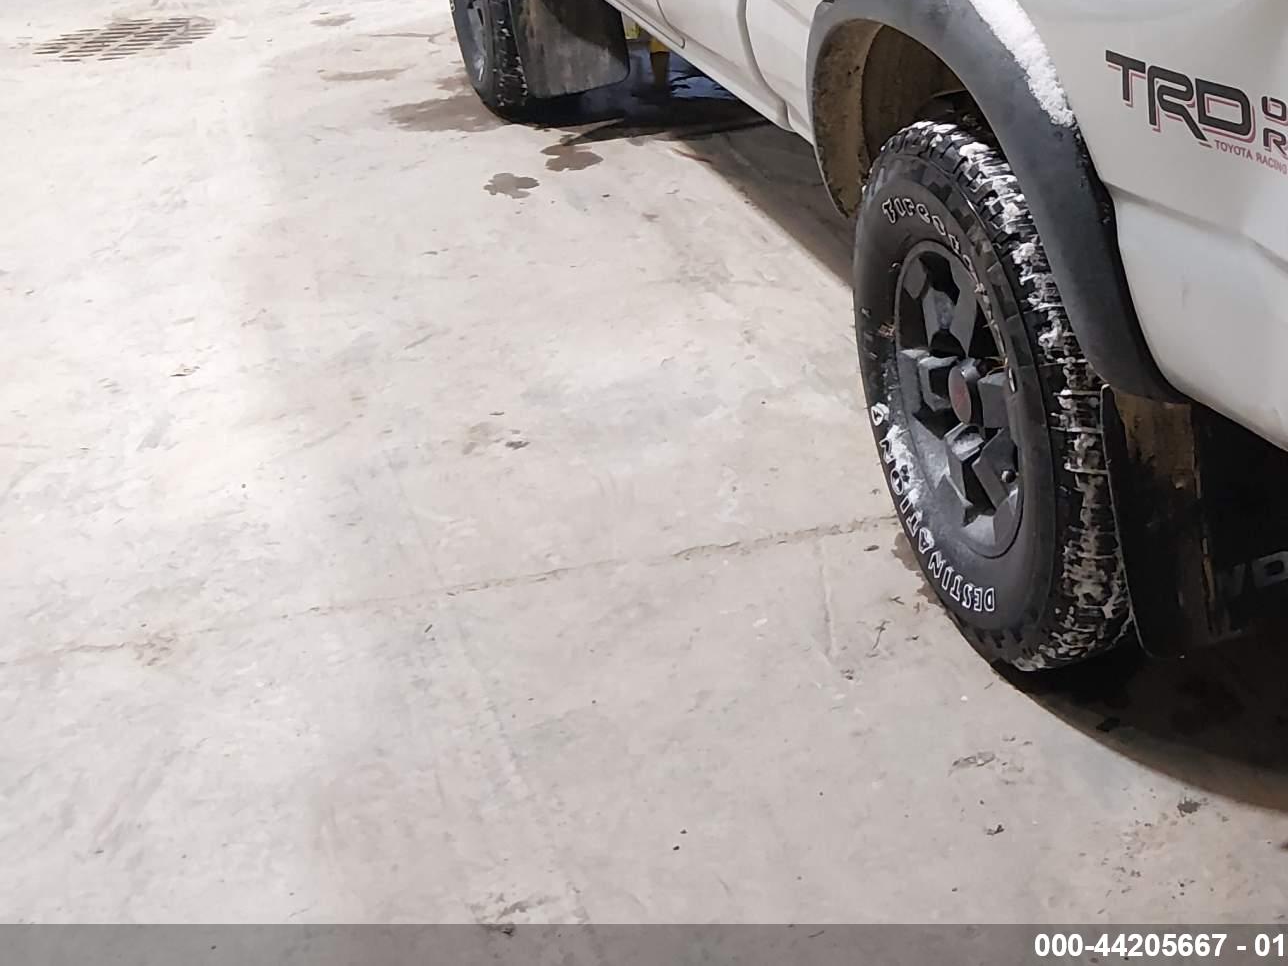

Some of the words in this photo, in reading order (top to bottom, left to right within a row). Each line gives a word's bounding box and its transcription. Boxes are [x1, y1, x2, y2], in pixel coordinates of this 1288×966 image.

[1105, 49, 1256, 148] TRD
[1214, 139, 1253, 161] TOYOTA
[1255, 152, 1288, 176] RACING
